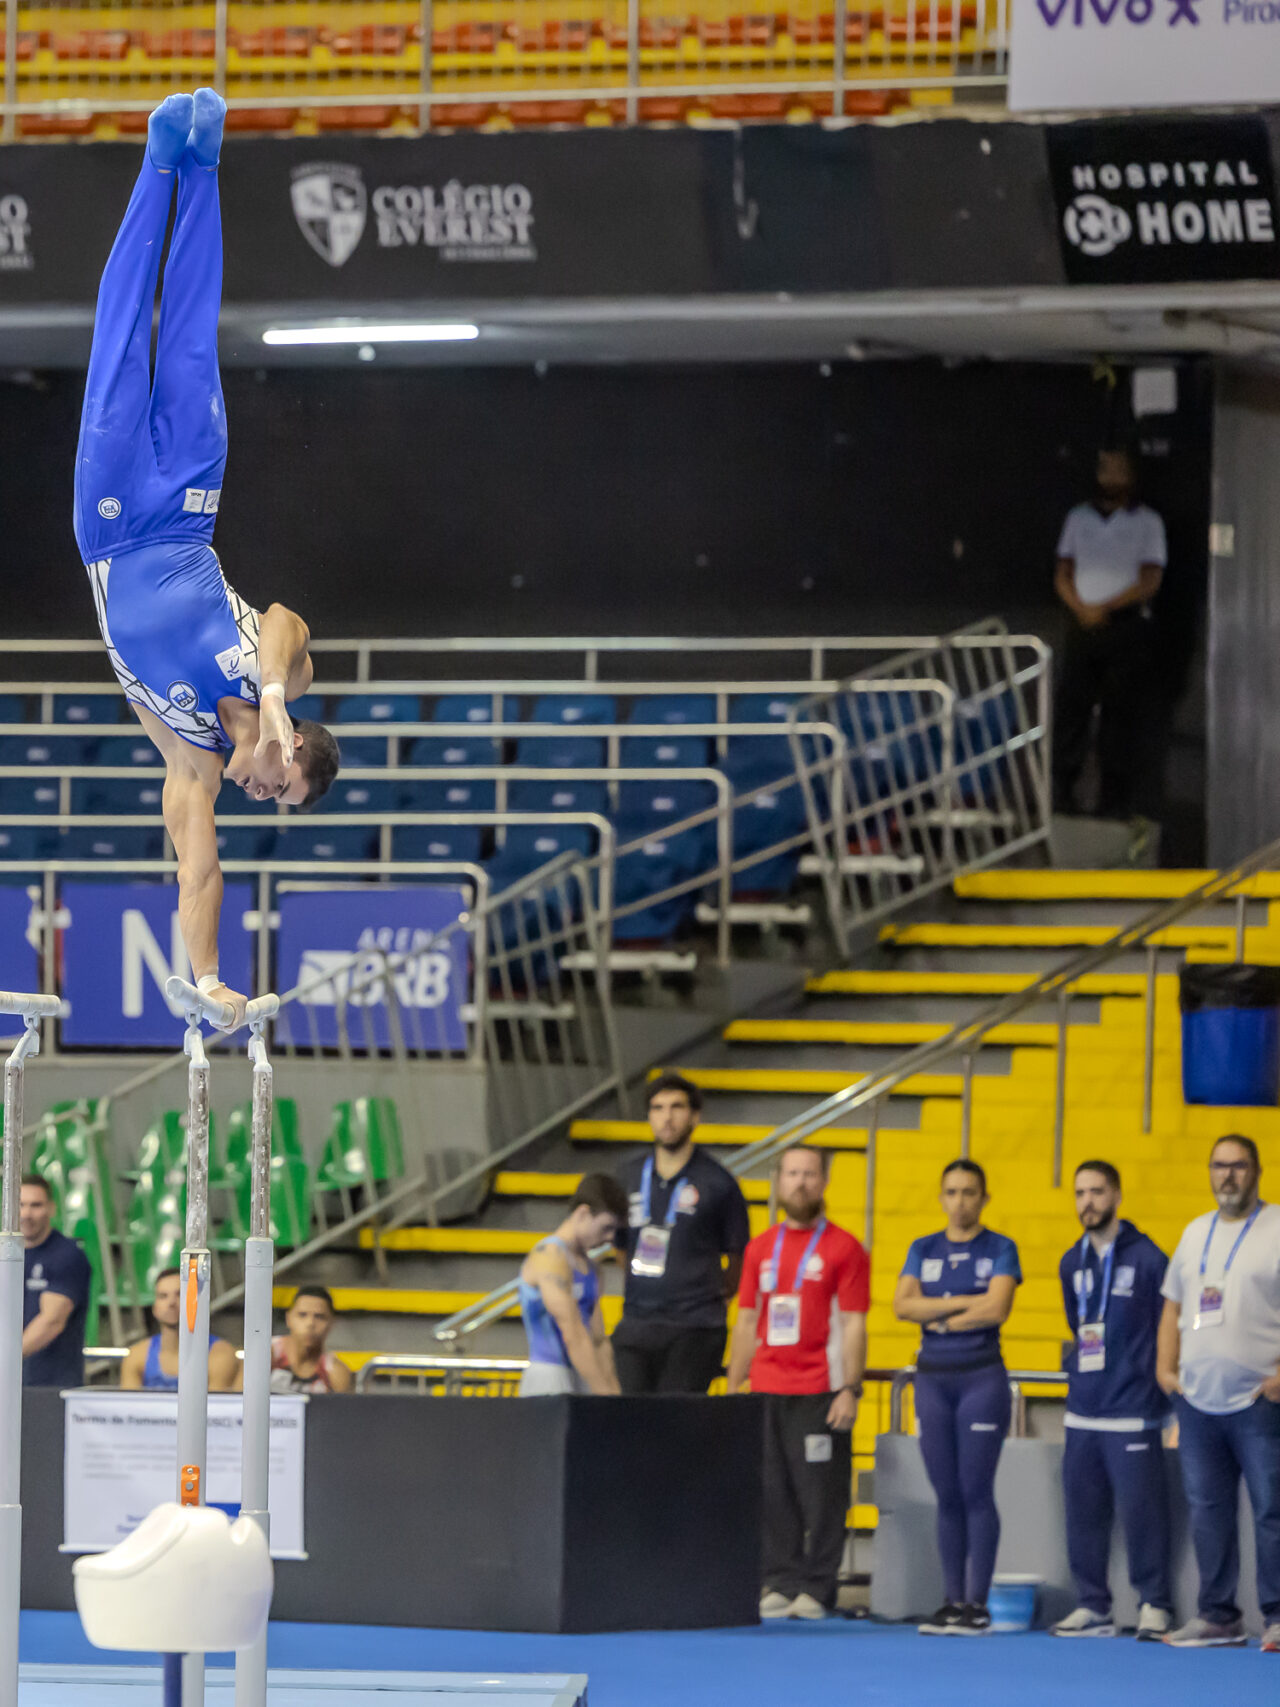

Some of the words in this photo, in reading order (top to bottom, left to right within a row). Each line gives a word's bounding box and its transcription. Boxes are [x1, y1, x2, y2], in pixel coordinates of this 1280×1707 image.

[1072, 160, 1259, 190] HOSPITAL
[372, 178, 532, 218] COLÉGIO
[376, 211, 535, 247] EVEREST
[1135, 198, 1276, 245] HOME
